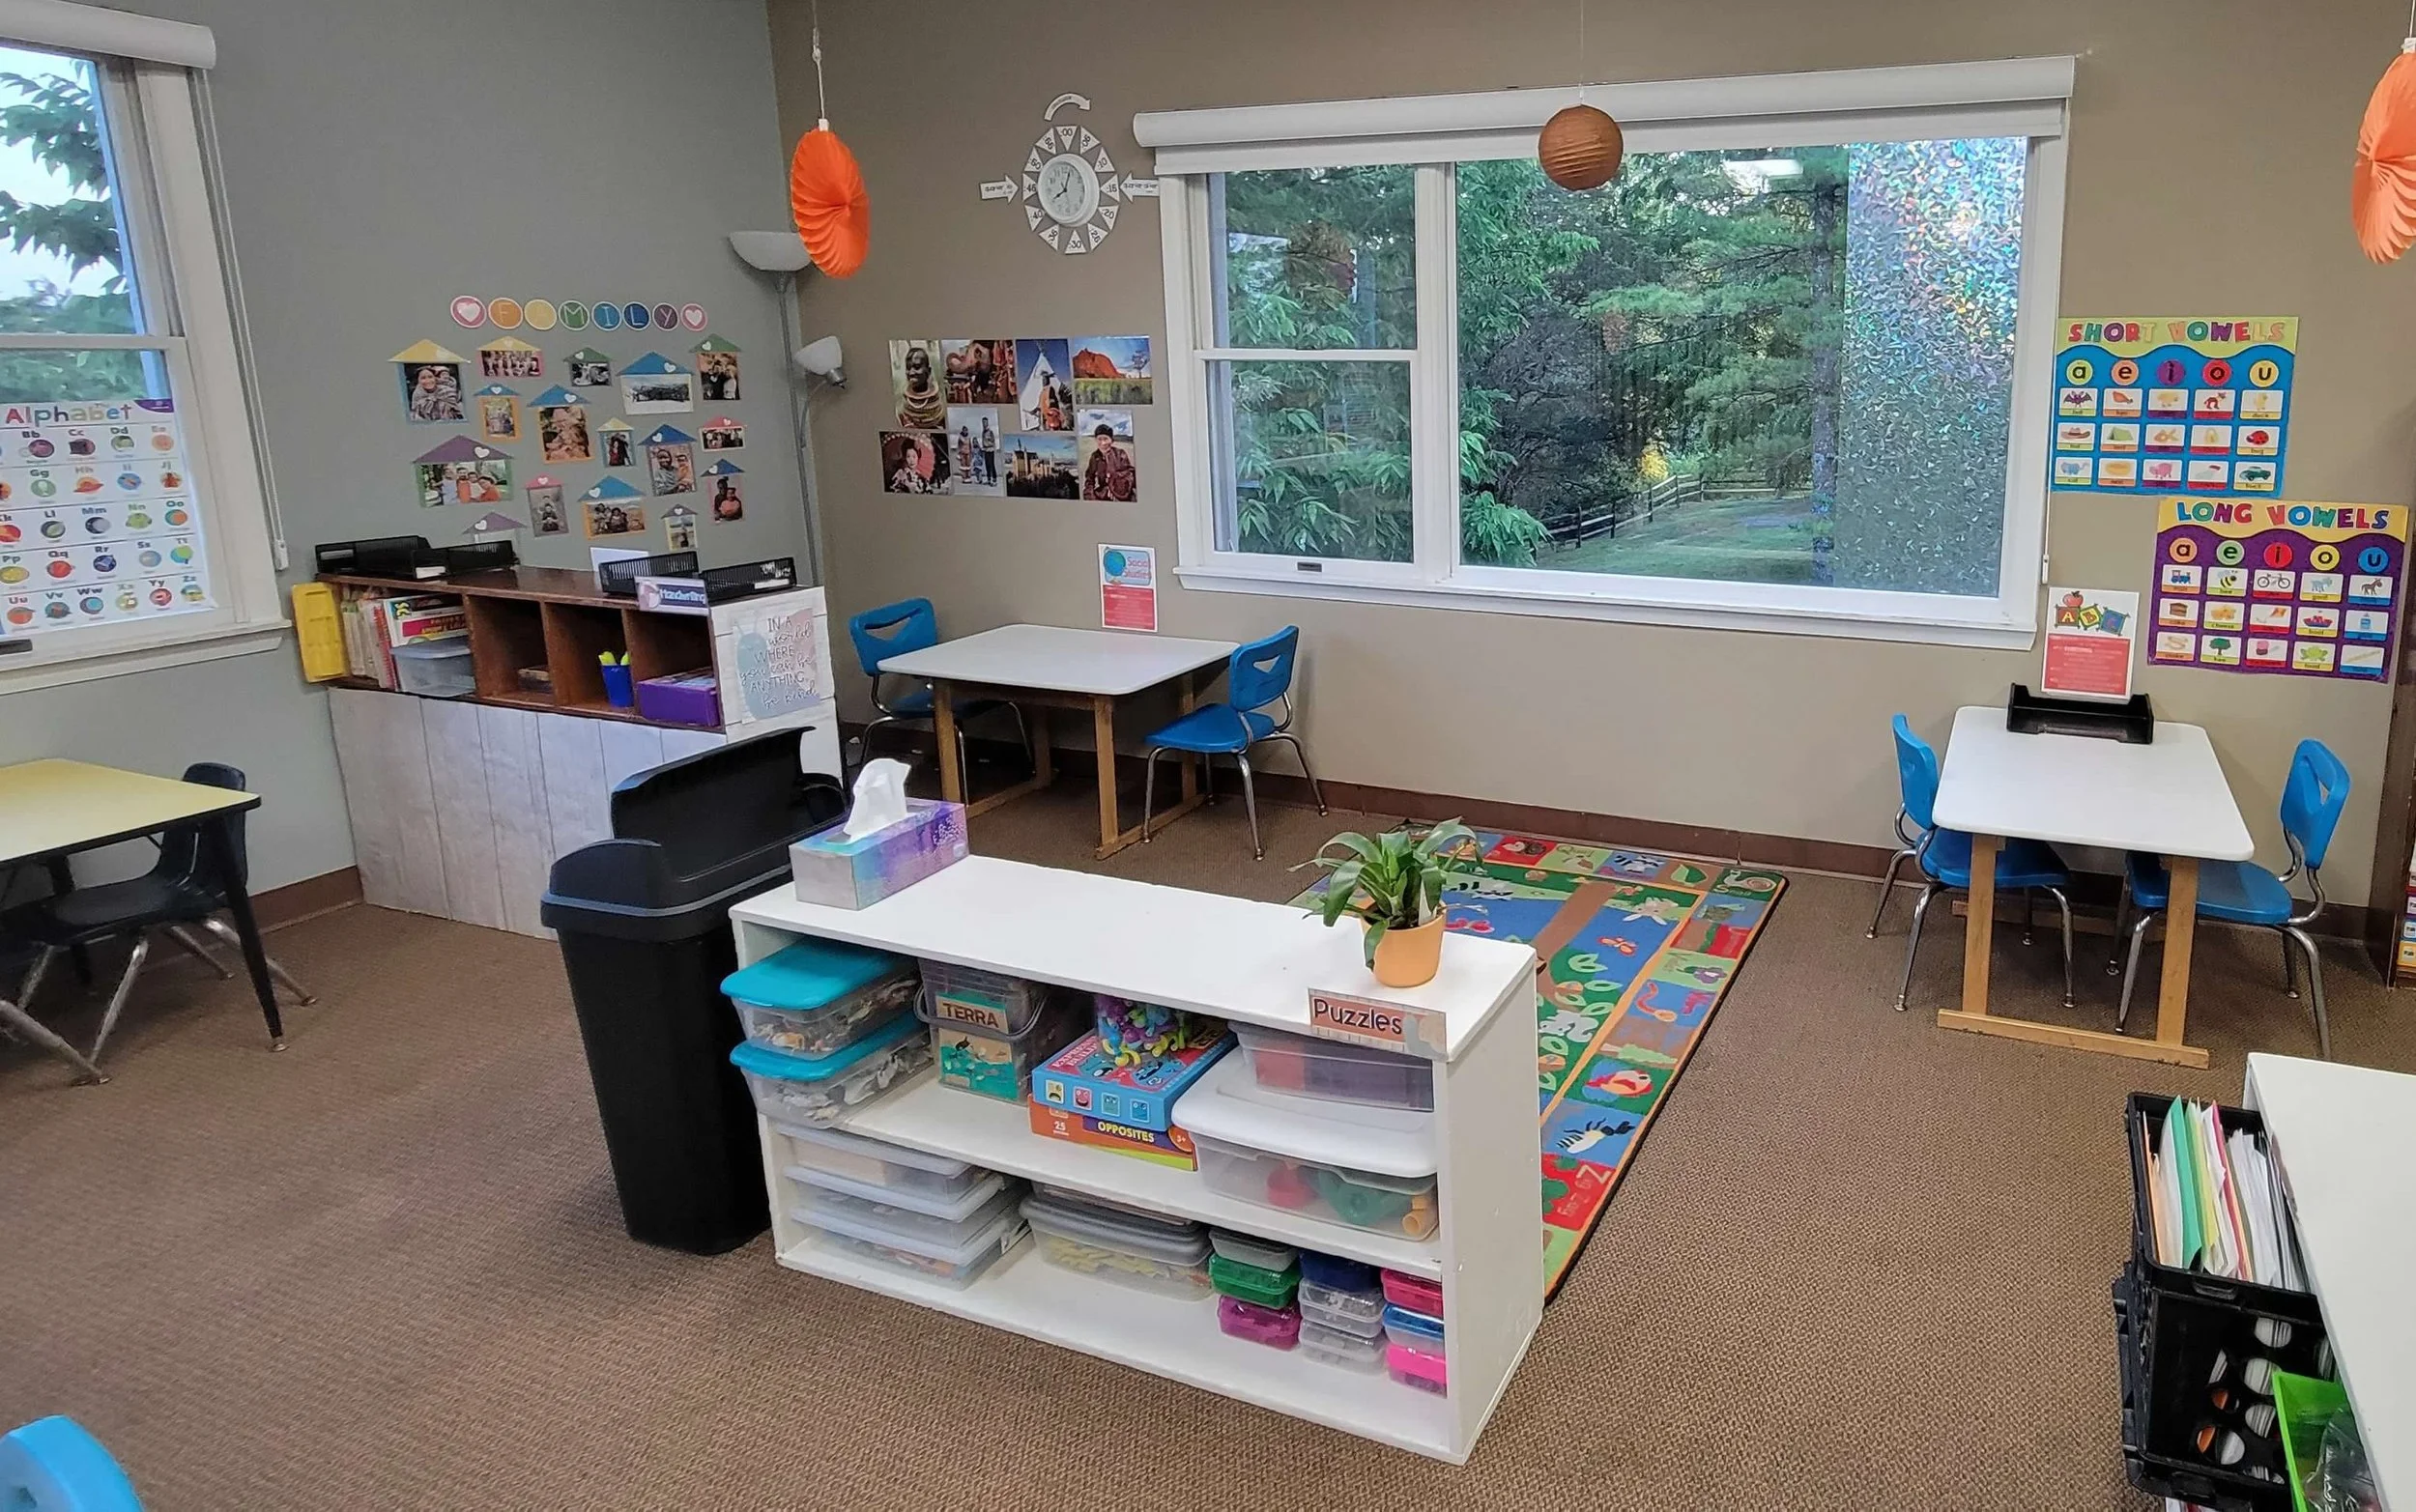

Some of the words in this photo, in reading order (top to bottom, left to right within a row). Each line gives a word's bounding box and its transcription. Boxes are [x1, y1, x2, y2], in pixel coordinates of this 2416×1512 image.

[498, 300, 674, 328] FMILY
[2068, 321, 2157, 343] SHORT
[2168, 320, 2286, 343] VOWELS
[2072, 365, 2086, 380] a
[2117, 365, 2133, 380] e
[2209, 365, 2225, 381] o
[2258, 366, 2272, 381] u
[6, 403, 132, 428] Alphabet
[68, 428, 85, 437] Cc
[109, 426, 129, 435] Dd
[29, 469, 49, 478] Gg
[2176, 501, 2253, 525] LONG
[2266, 503, 2390, 530] VOWELS
[2175, 543, 2191, 557] a
[2223, 546, 2238, 560] e
[2317, 551, 2333, 565] o
[2368, 552, 2382, 566] u
[767, 616, 781, 633] IN
[785, 615, 793, 628] A
[2061, 611, 2076, 623] A
[754, 644, 795, 664] WHERE
[751, 670, 805, 694] ANYTHING
[941, 1002, 999, 1029] TERRA
[1313, 998, 1402, 1036] Puzzles
[1097, 1121, 1155, 1144] OPPOSITES
